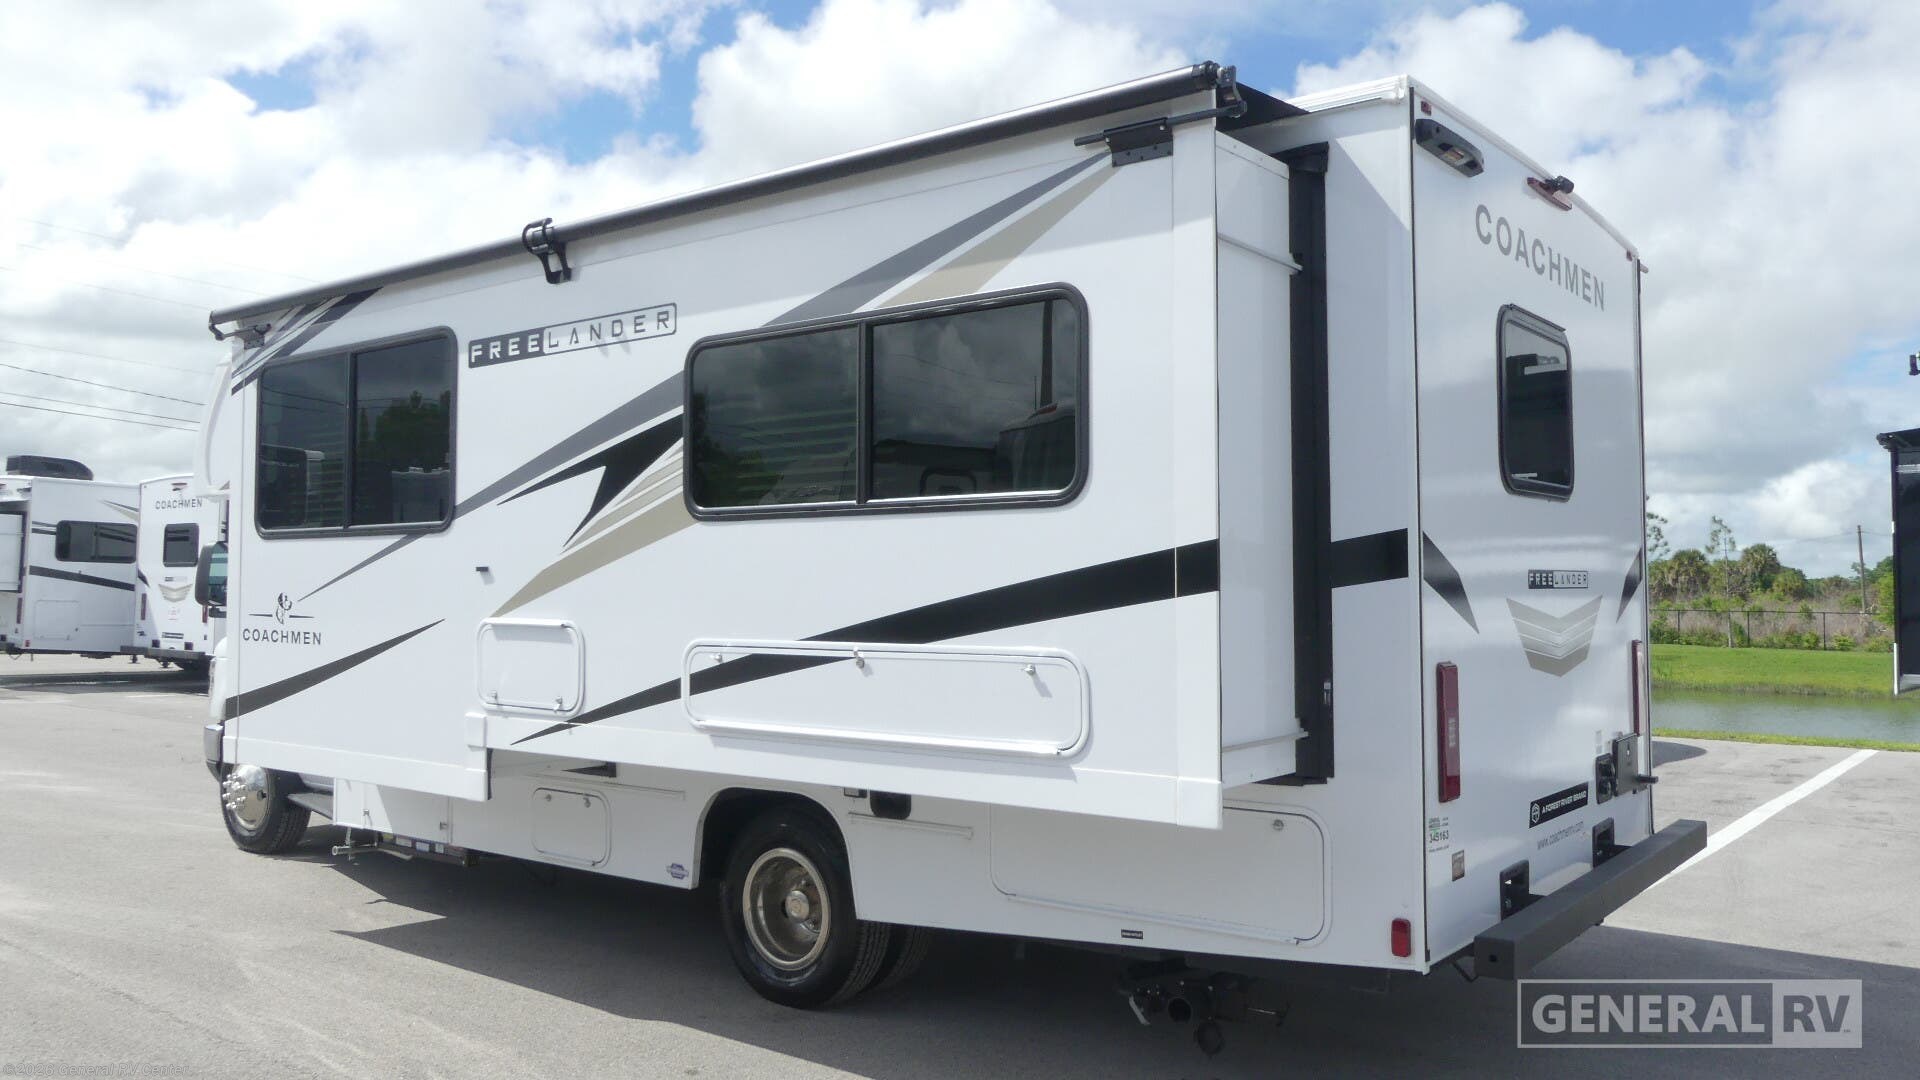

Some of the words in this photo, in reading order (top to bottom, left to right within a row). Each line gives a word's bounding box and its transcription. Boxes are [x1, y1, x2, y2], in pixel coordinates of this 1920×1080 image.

[1475, 204, 1605, 311] COACHMEN
[471, 310, 671, 363] FREELANDER
[155, 498, 202, 510] COACHMEN
[1528, 573, 1587, 586] FREELANDER
[242, 628, 322, 645] COACHMEN
[1545, 799, 1561, 812] FOREST
[1560, 795, 1573, 807] RIVER
